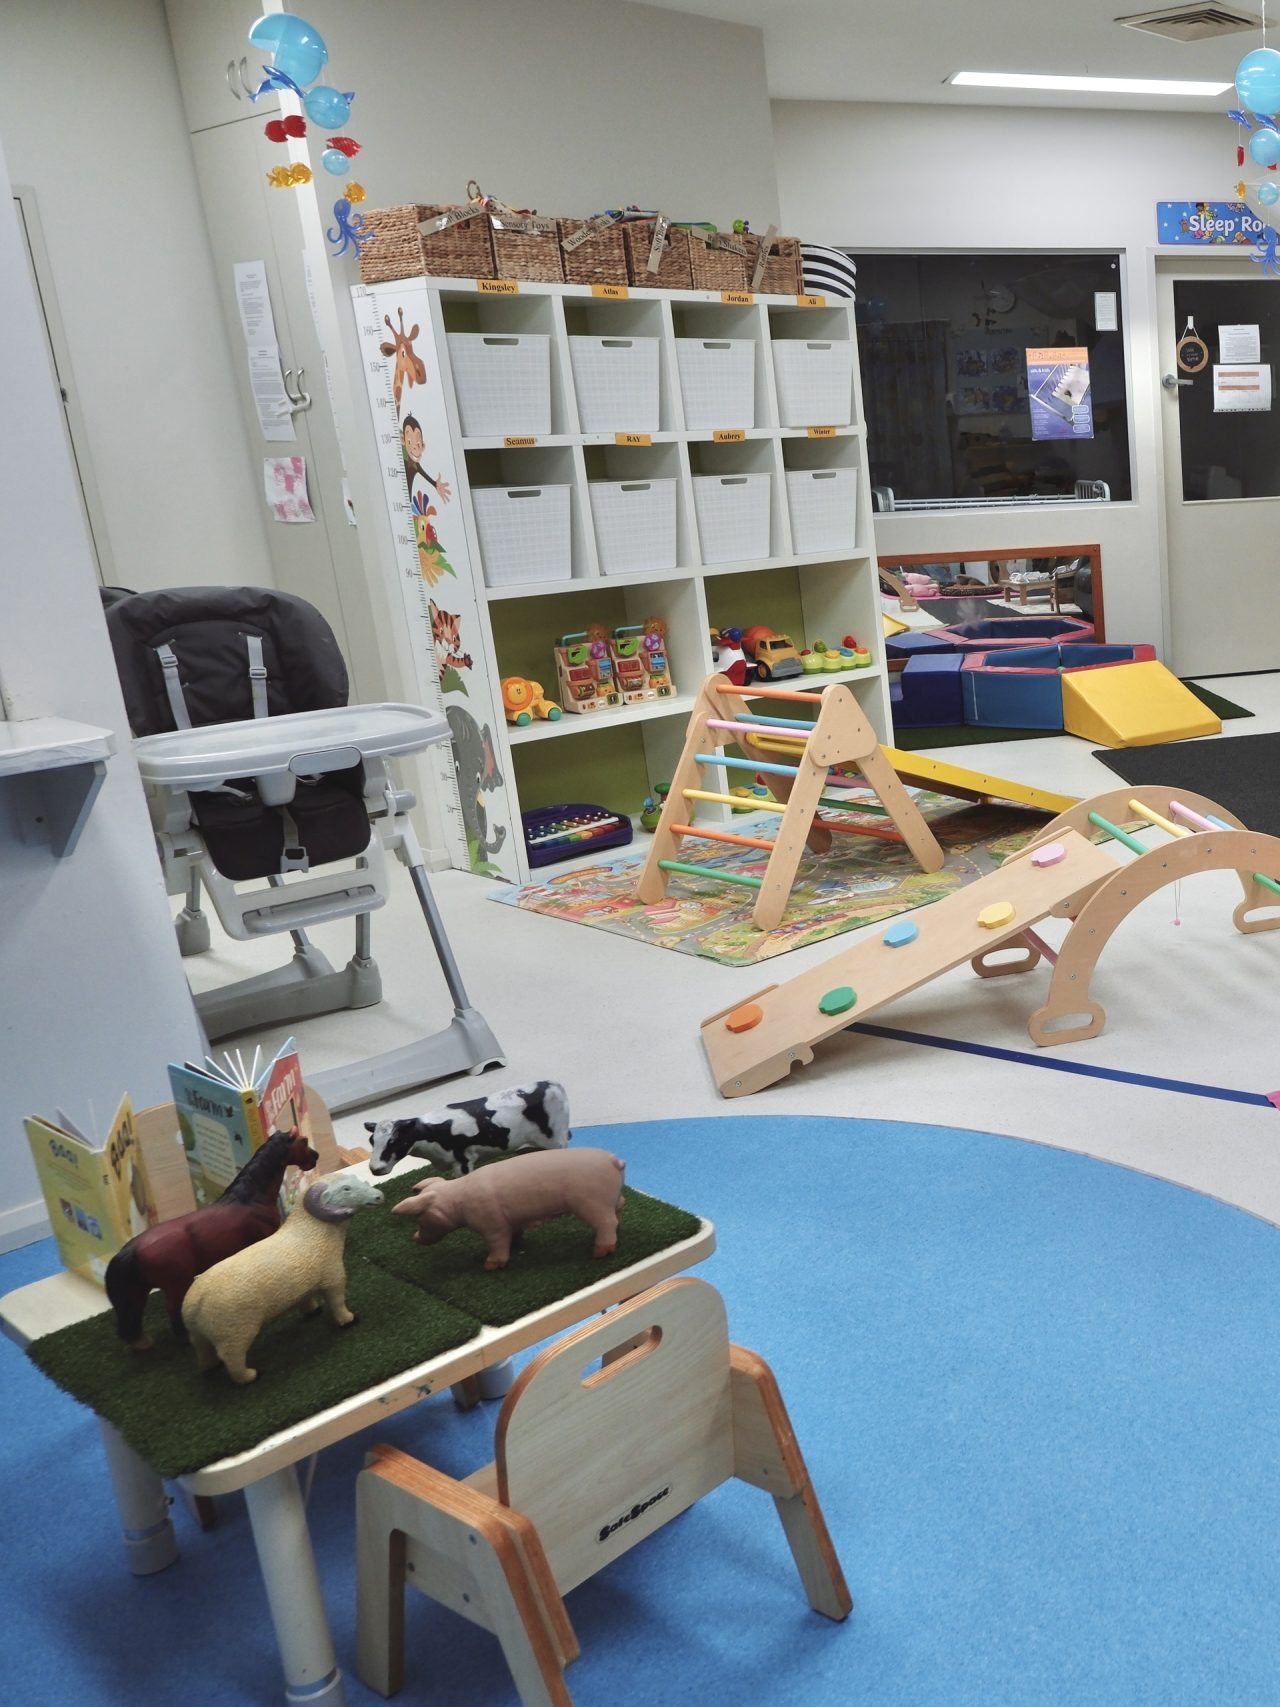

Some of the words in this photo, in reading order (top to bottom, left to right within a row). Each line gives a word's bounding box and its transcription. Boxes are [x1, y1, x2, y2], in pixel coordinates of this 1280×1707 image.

[454, 206, 480, 221] Blocks
[531, 221, 550, 230] Toys
[1189, 215, 1235, 236] Sleep
[1241, 216, 1265, 232] Ro
[567, 229, 594, 247] Woode
[482, 282, 516, 293] Kingsley
[727, 294, 749, 303] Jordan
[506, 437, 535, 446] Seamus
[626, 435, 641, 443] RAY
[718, 433, 741, 441] Aubrey
[269, 1068, 297, 1111] Farm
[192, 1089, 224, 1118] Farm
